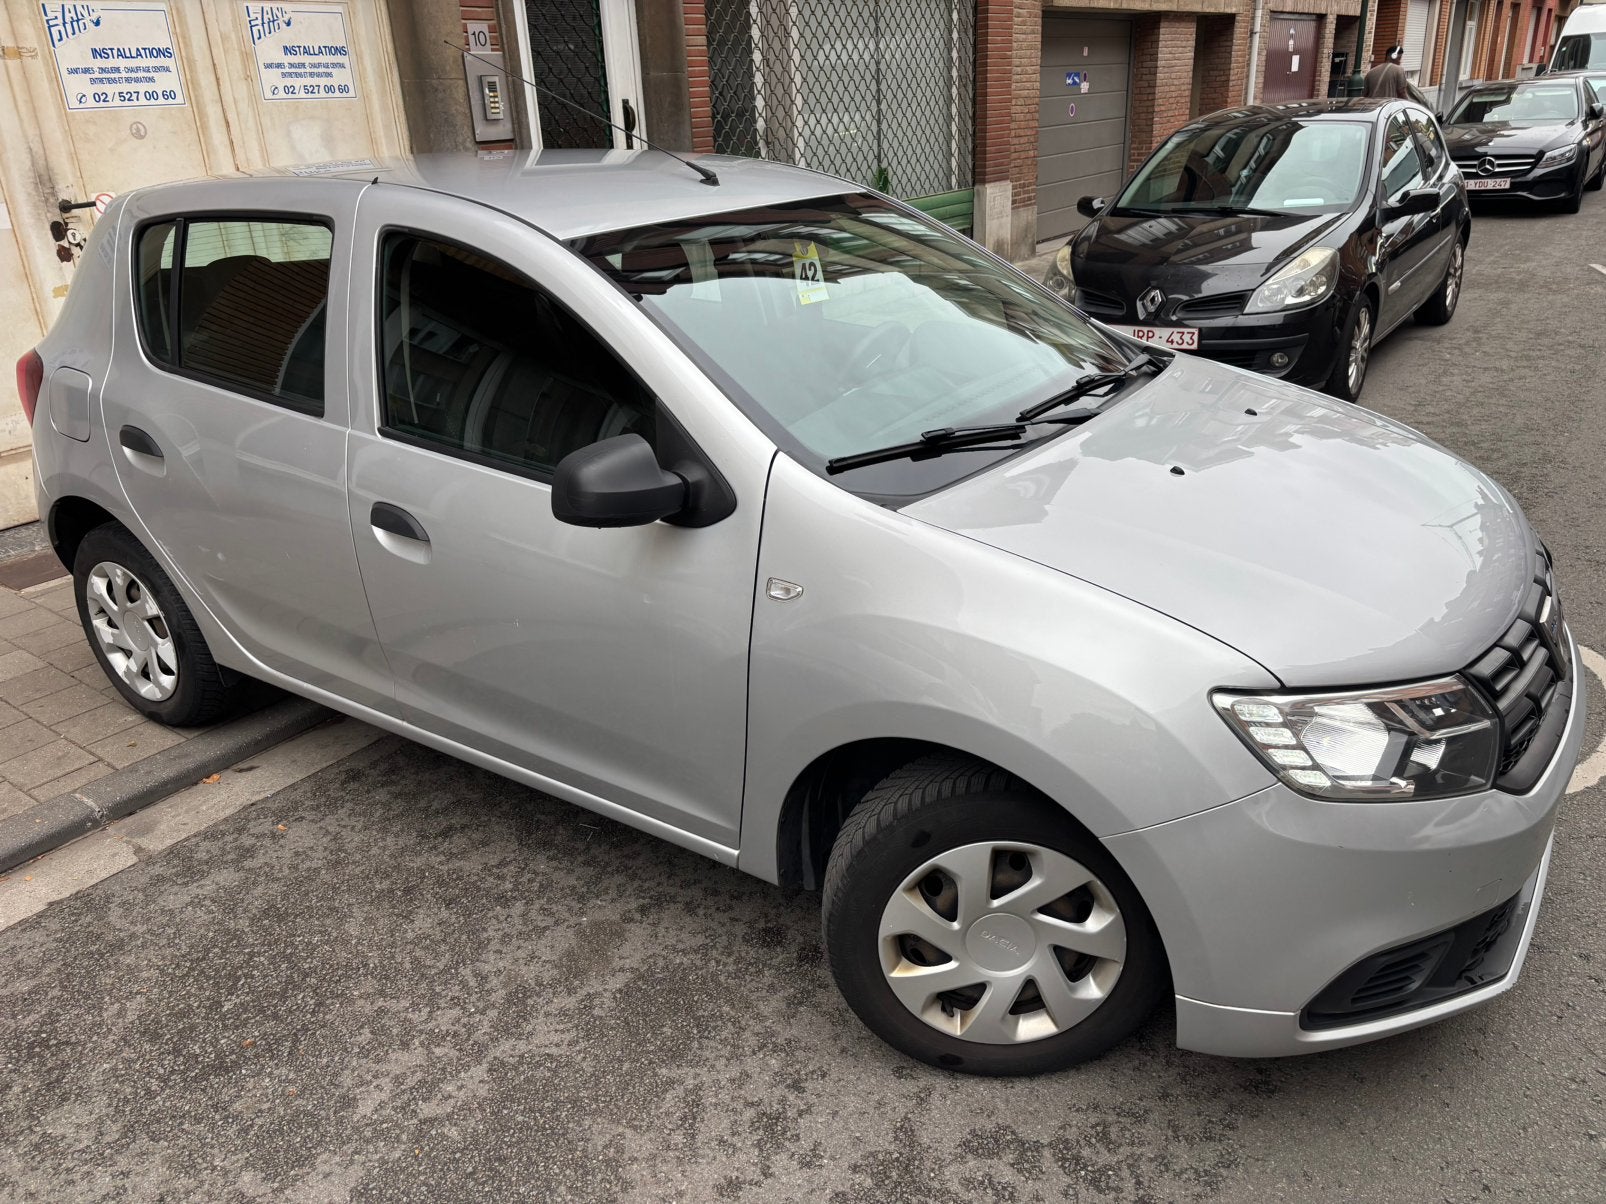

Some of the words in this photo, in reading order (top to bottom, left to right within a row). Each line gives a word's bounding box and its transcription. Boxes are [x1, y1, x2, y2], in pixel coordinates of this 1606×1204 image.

[471, 30, 487, 47] 10
[91, 47, 173, 59] INSTALLATIONS
[283, 45, 347, 56] INSTALLATIONS
[66, 66, 95, 75] SANITAIRES
[97, 66, 122, 74] ZINGUERIE
[124, 66, 151, 74] CHAUFFAGE
[151, 65, 172, 73] CENTRAL
[144, 90, 159, 101] 00
[161, 89, 177, 100] 60
[323, 84, 336, 94] 00
[337, 84, 350, 94] 60
[800, 261, 820, 285] 42
